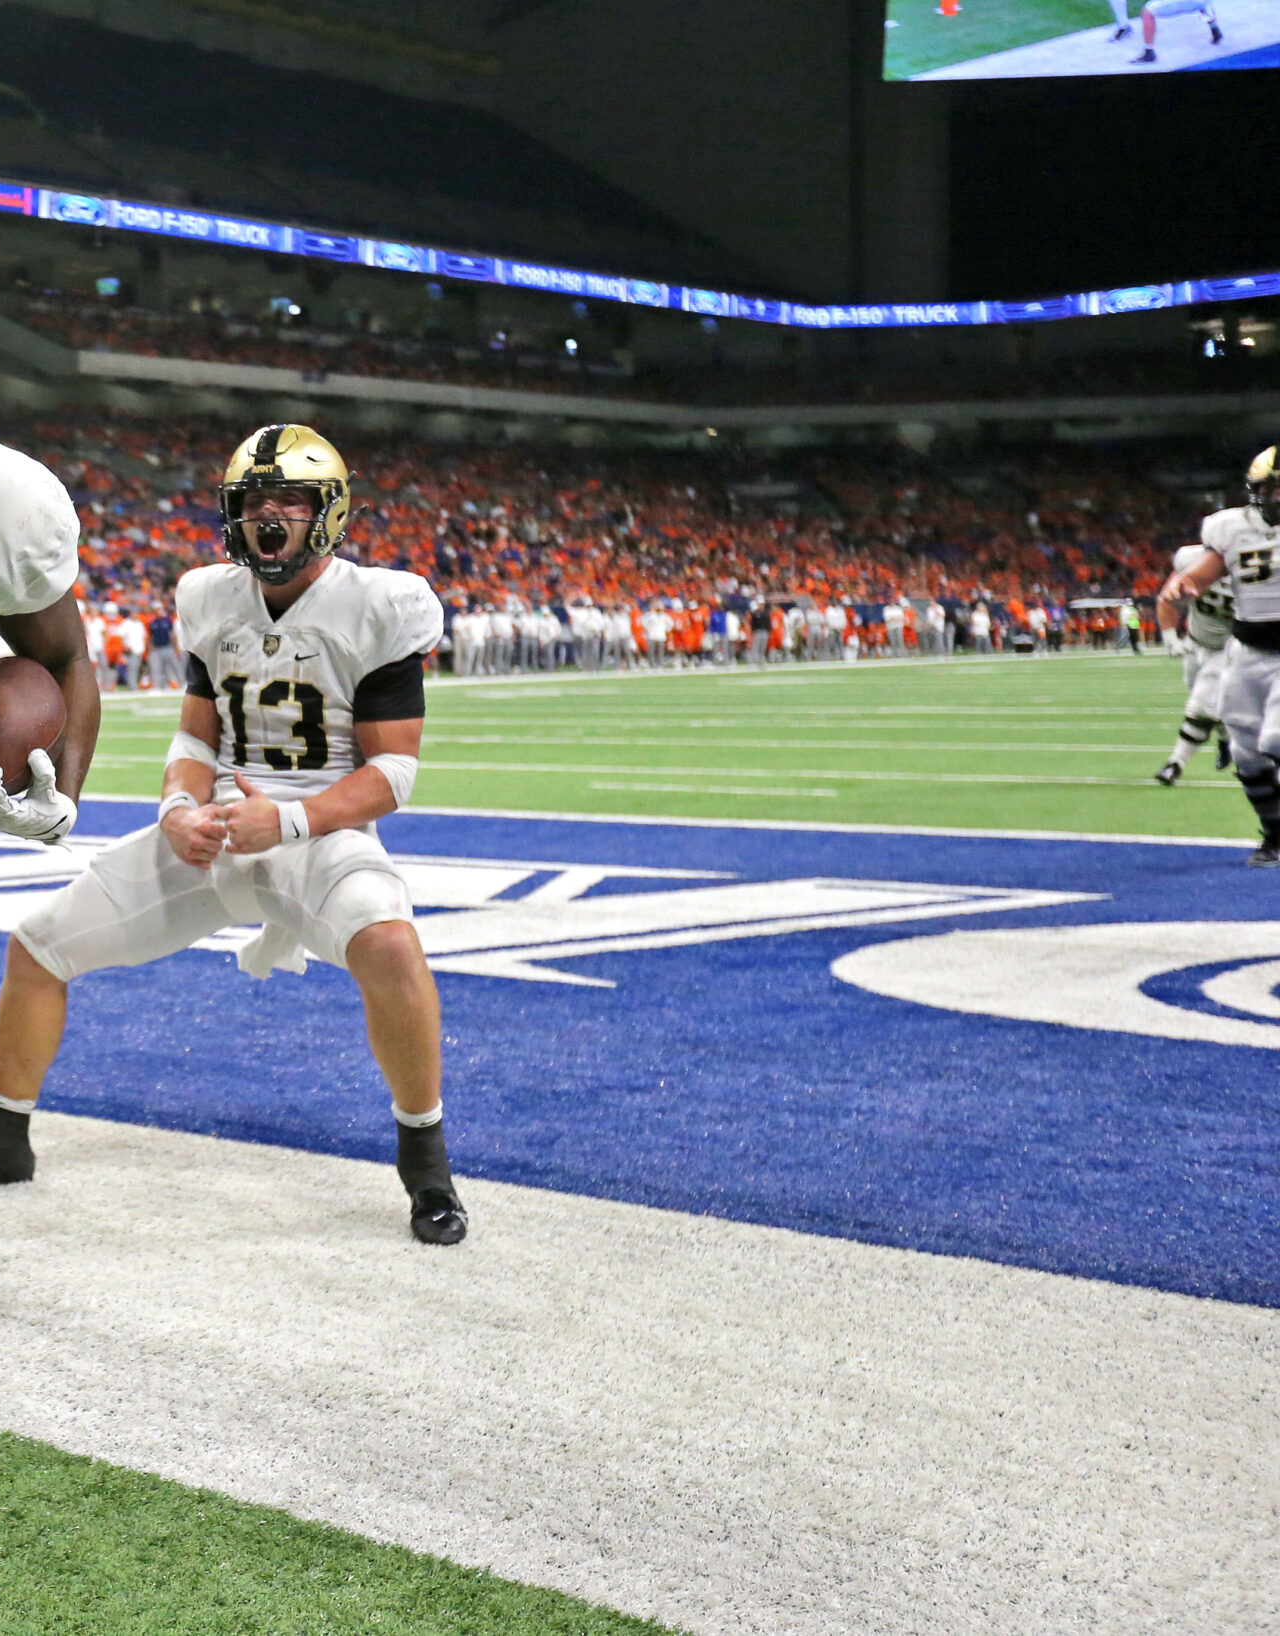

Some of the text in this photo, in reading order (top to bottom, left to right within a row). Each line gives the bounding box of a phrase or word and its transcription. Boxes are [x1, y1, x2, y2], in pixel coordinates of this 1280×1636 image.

[116, 202, 162, 229] FORD
[215, 219, 271, 246] TRUCK
[512, 264, 549, 287] FORD
[794, 305, 830, 326] FORD
[892, 304, 959, 323] TRUCK
[251, 464, 275, 474] ARMY
[220, 671, 329, 771] 13
